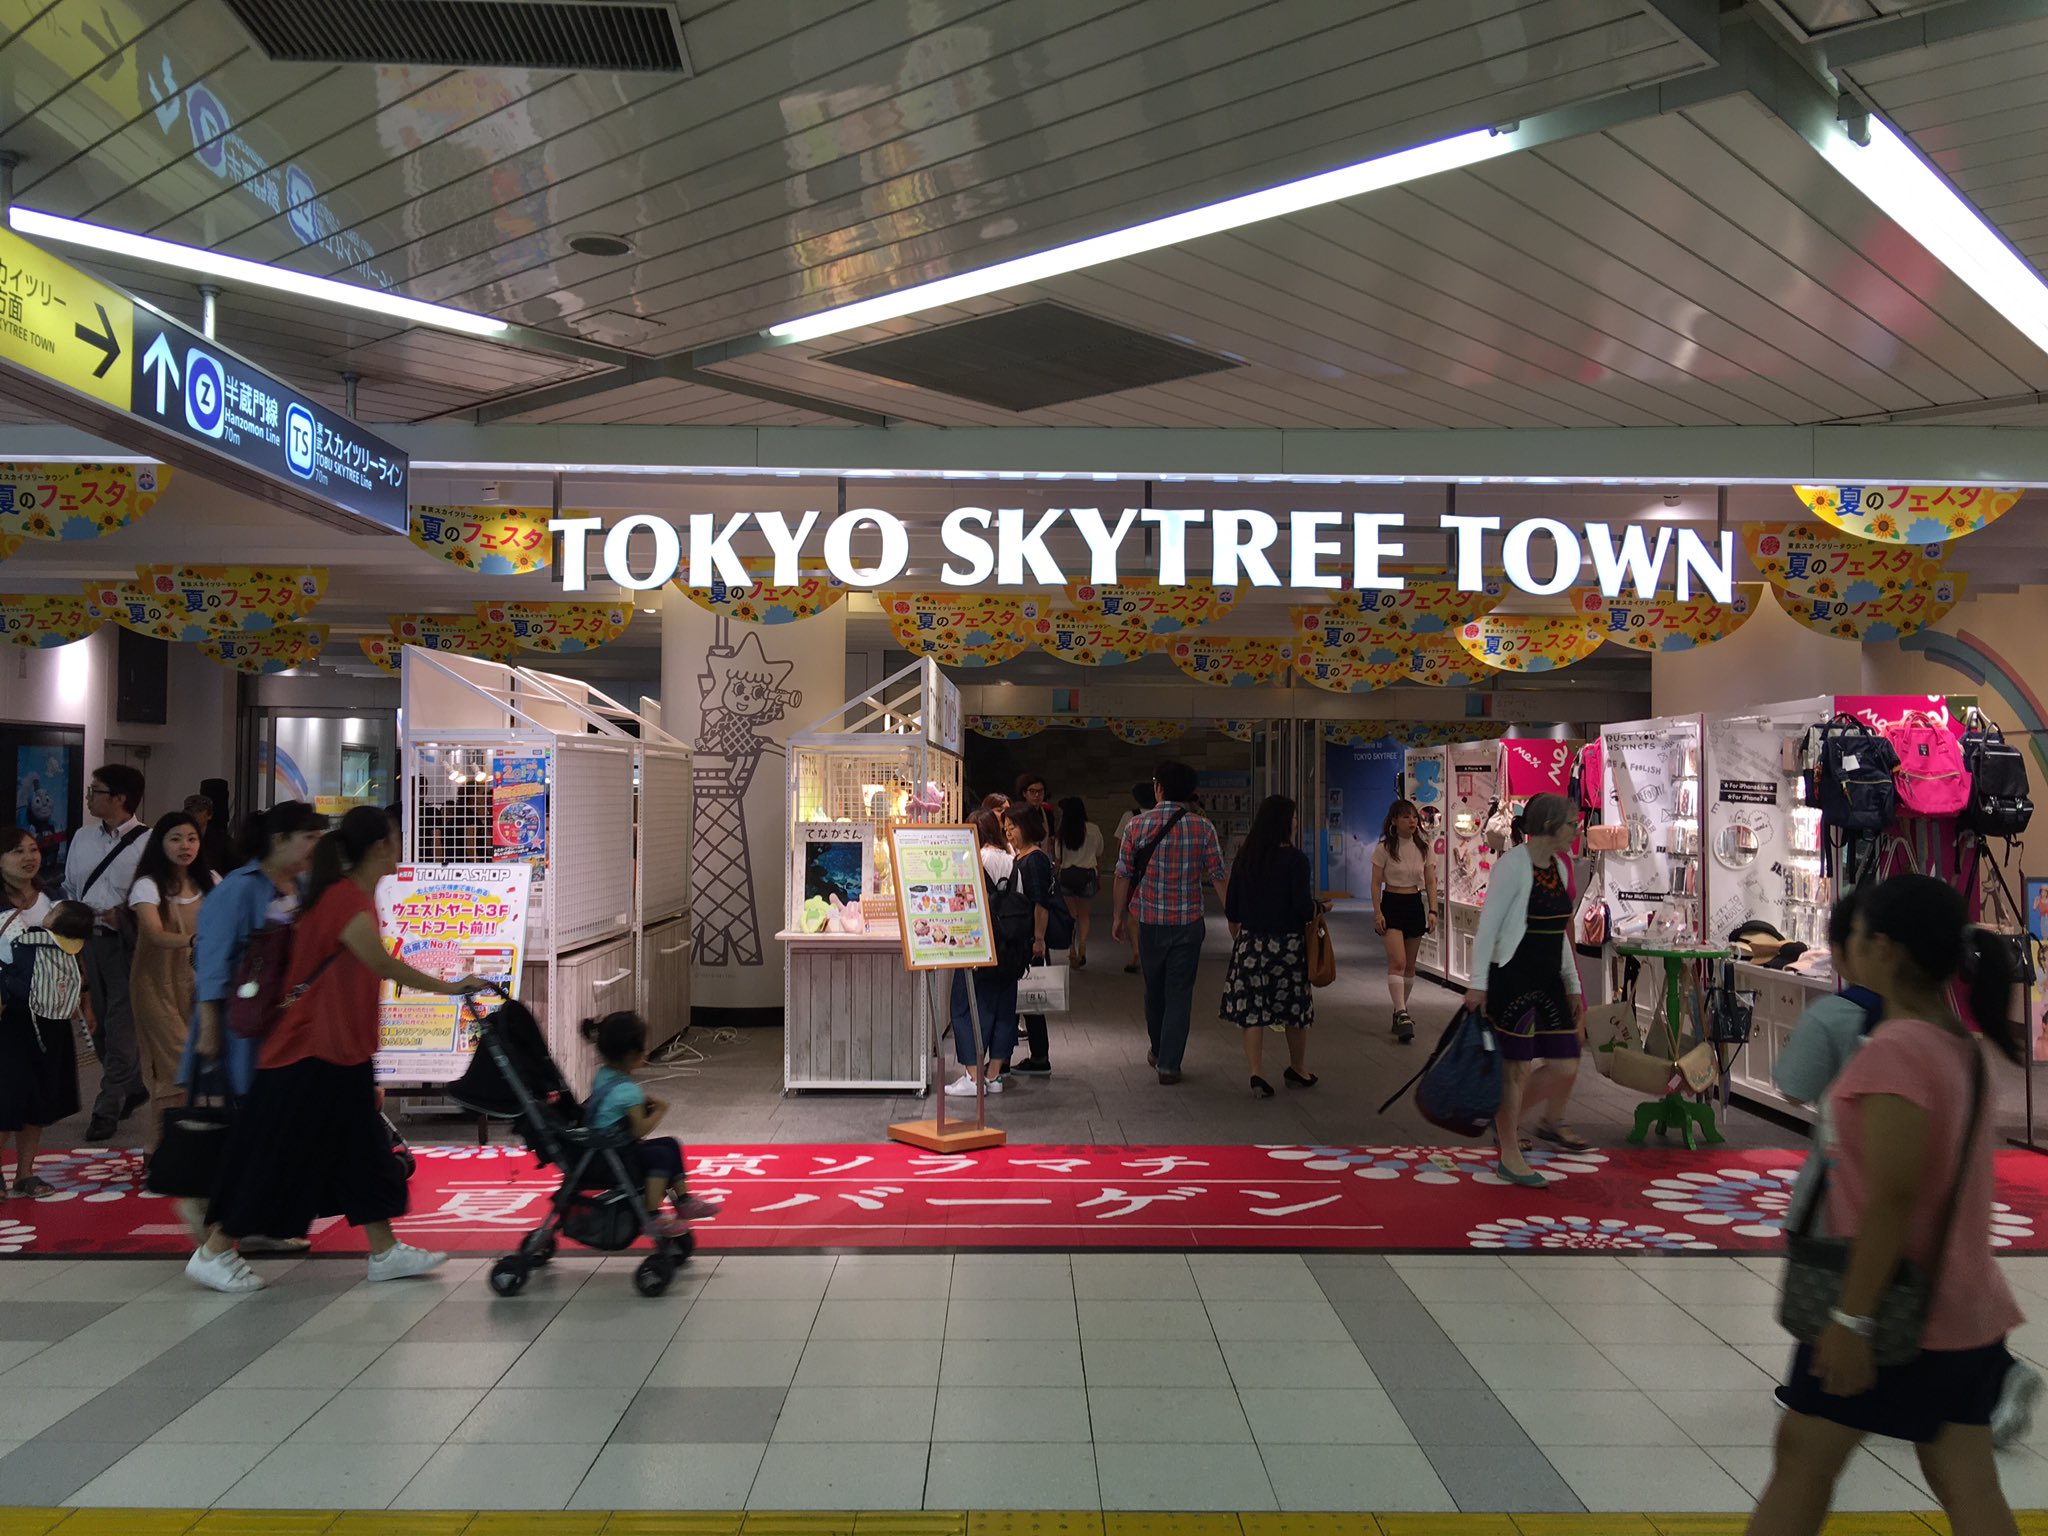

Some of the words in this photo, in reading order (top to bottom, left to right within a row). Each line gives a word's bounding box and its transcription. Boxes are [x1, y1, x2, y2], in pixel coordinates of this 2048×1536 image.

[30, 331, 55, 354] TOWN
[200, 380, 211, 408] Z
[225, 374, 279, 428] 半蔵門線
[224, 407, 264, 440] Hanzomon
[265, 428, 281, 447] Line
[224, 425, 241, 446] 70m
[292, 425, 309, 456] TS
[323, 428, 403, 488] スカイツリーライン
[0, 473, 68, 481] スカイツリータウン
[315, 452, 333, 471] TOBU
[333, 461, 360, 485] SKYTREE
[360, 474, 373, 491] Line
[315, 469, 329, 486] 70m
[1835, 485, 1982, 517] 夏のフェスタ
[420, 514, 543, 551] 夏のフェスタ
[548, 507, 909, 592] TOKYO
[940, 506, 1405, 588] SKYTREE
[1440, 515, 1734, 603] TOWN
[1784, 549, 1913, 580] 夏のフェスタ
[181, 588, 294, 613] 夏のフェスタ
[1101, 595, 1209, 616] 夏のフェスタ
[1358, 587, 1474, 612] 夏のフェスタ
[511, 617, 604, 638] 夏のフェスタ
[916, 610, 1015, 630] 夏のフェスタ
[1607, 605, 1722, 632] 夏のフェスタ
[219, 639, 302, 660] 夏のフェスタ
[1056, 629, 1148, 650] 夏のフェスタ
[1484, 635, 1578, 656] 夏のフェスタ
[1193, 653, 1274, 672] 夏のフェスタ
[1315, 663, 1391, 680] 夏のフェスタ
[805, 828, 863, 840] てながさん
[392, 903, 510, 917] ウエストヤード3F
[1610, 1016, 1632, 1041] CATUS
[552, 1153, 1210, 1178] 京ソラマチ
